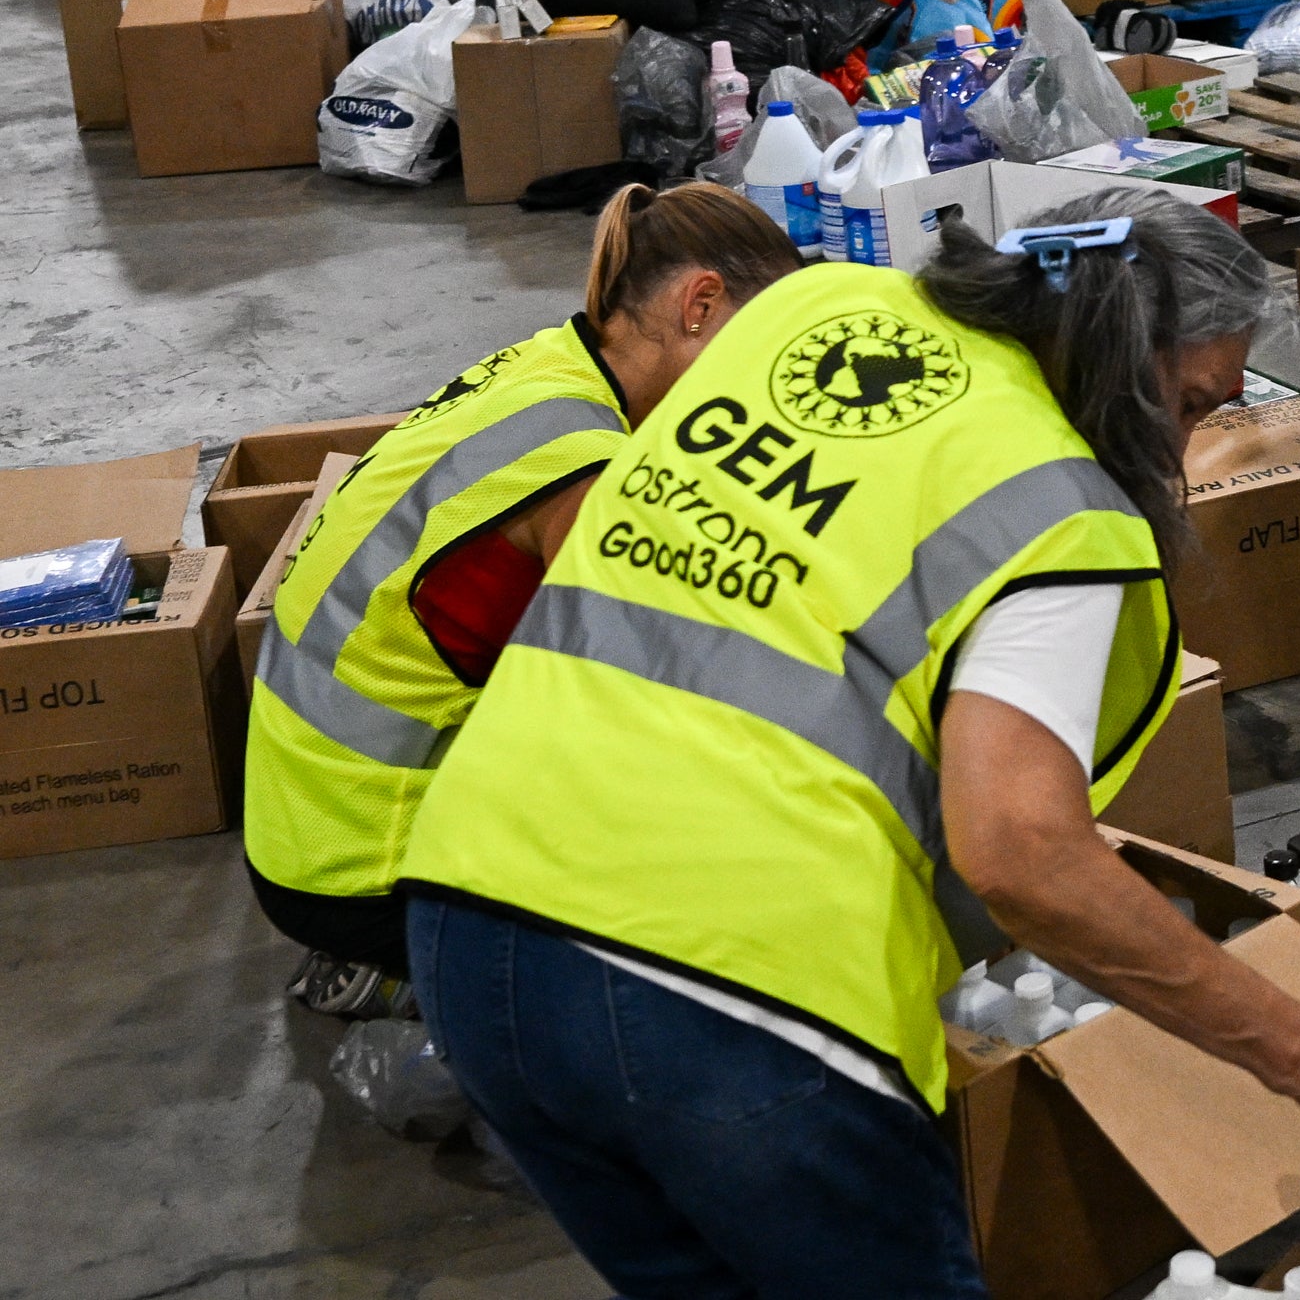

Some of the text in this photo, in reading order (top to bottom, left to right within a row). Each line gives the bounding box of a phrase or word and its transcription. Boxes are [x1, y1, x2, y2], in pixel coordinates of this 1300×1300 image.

[1195, 81, 1221, 95] SAVE
[1198, 92, 1221, 107] 20%
[333, 99, 401, 123] OLD NAVY
[1143, 111, 1162, 122] OAP
[675, 395, 859, 538] GEM
[1229, 465, 1292, 486] DAILY
[1181, 480, 1225, 496] RAT
[1238, 515, 1300, 552] FLAP
[598, 520, 779, 609] Good360
[0, 613, 181, 639] REDUCED SO
[0, 678, 105, 714] TOP FL
[0, 760, 181, 795] ated Flameless Ration
[11, 784, 141, 814] each menu bag
